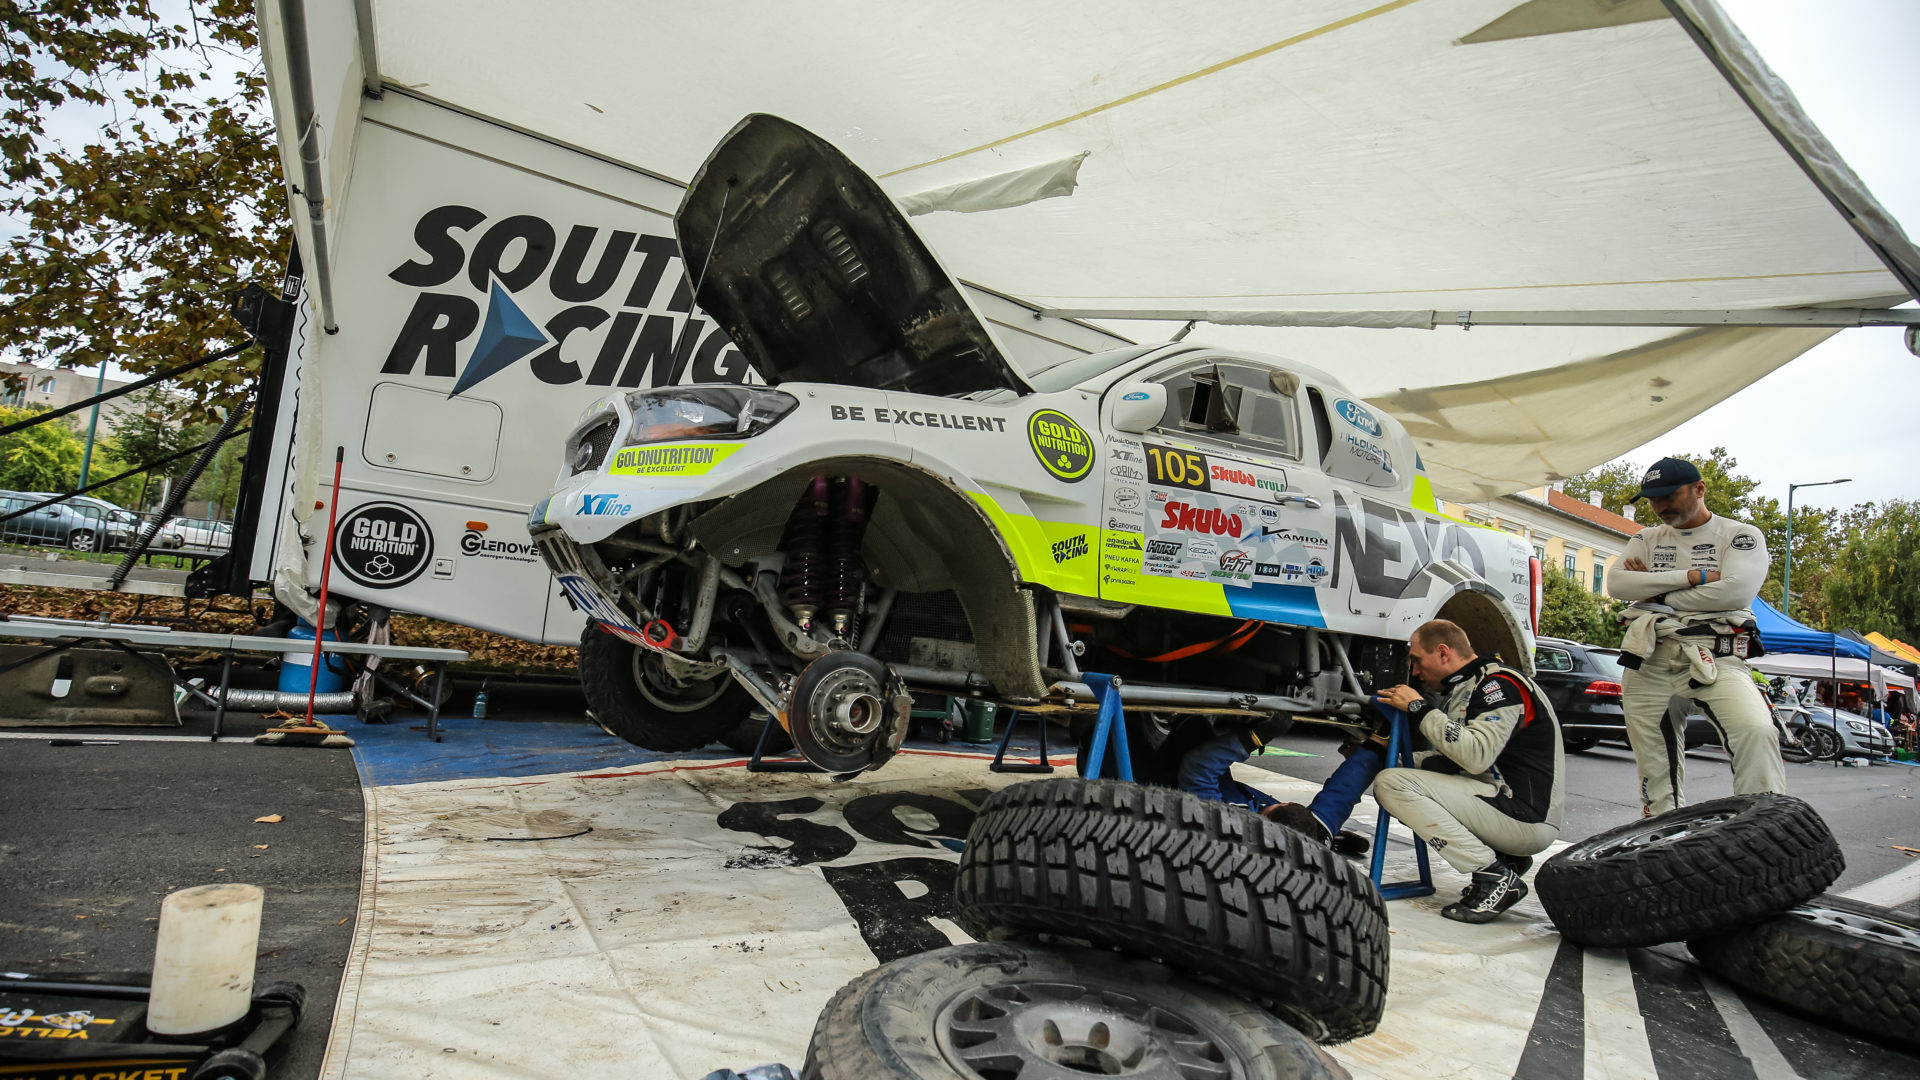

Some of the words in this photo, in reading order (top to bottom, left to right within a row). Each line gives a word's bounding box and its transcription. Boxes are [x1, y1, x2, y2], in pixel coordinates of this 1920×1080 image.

[831, 405, 866, 422] BE
[875, 408, 1006, 433] EXCELLENT
[1347, 402, 1377, 433] Ford
[1037, 420, 1082, 443] GOLD
[1037, 434, 1087, 457] NUTRITION
[1349, 446, 1381, 465] MOTORS
[616, 447, 714, 469] GOLDNUTRITION
[1110, 449, 1144, 464] XTline
[1149, 448, 1205, 486] 105
[646, 465, 686, 473] EXCELLENT
[1115, 465, 1139, 478] PRIM
[576, 493, 632, 516] XTline
[1261, 509, 1278, 518] SBS
[353, 517, 418, 543] GOLD
[350, 537, 415, 556] NUTRITION
[461, 534, 542, 557] GLENOWE
[1052, 533, 1086, 554] SOUTH
[1146, 540, 1182, 556] HTRT
[1105, 554, 1120, 562] PNEU
[1121, 555, 1140, 564] KAFKA
[1220, 557, 1254, 573] HT
[1485, 692, 1504, 703] OMP
[1479, 881, 1508, 909] sparco
